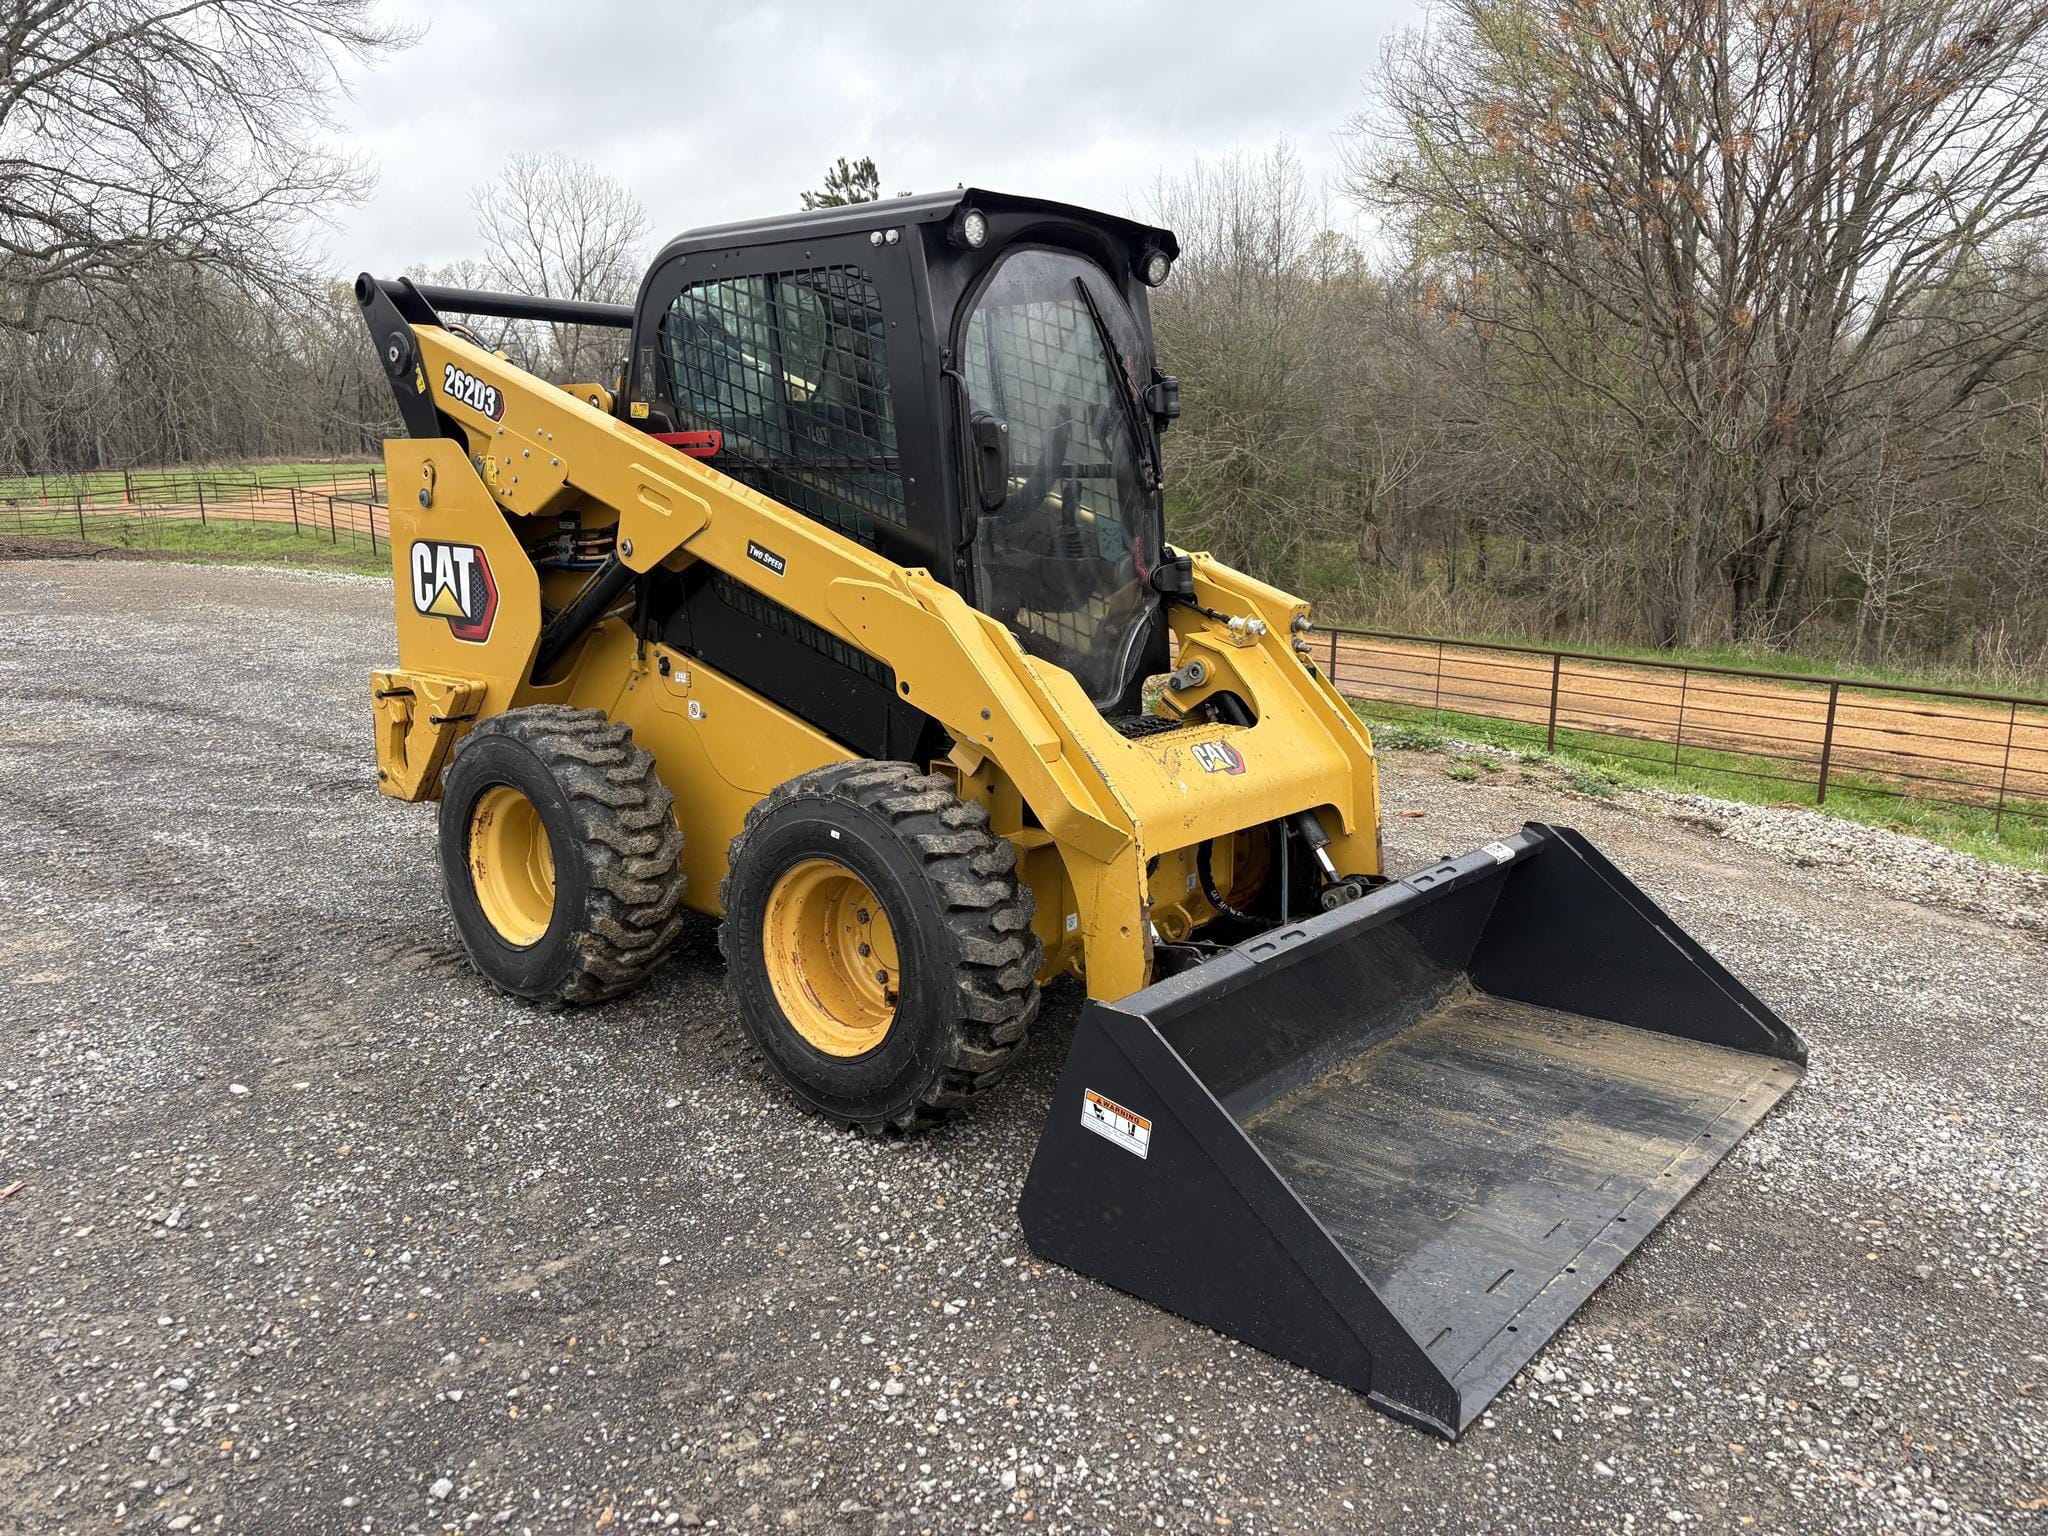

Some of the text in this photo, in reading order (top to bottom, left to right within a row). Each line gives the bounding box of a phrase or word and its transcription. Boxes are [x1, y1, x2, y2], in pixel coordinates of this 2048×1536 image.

[444, 363, 497, 417] 262D3
[411, 541, 475, 618] CAT
[1190, 740, 1236, 772] CAT
[1103, 1099, 1140, 1125] WARNING
